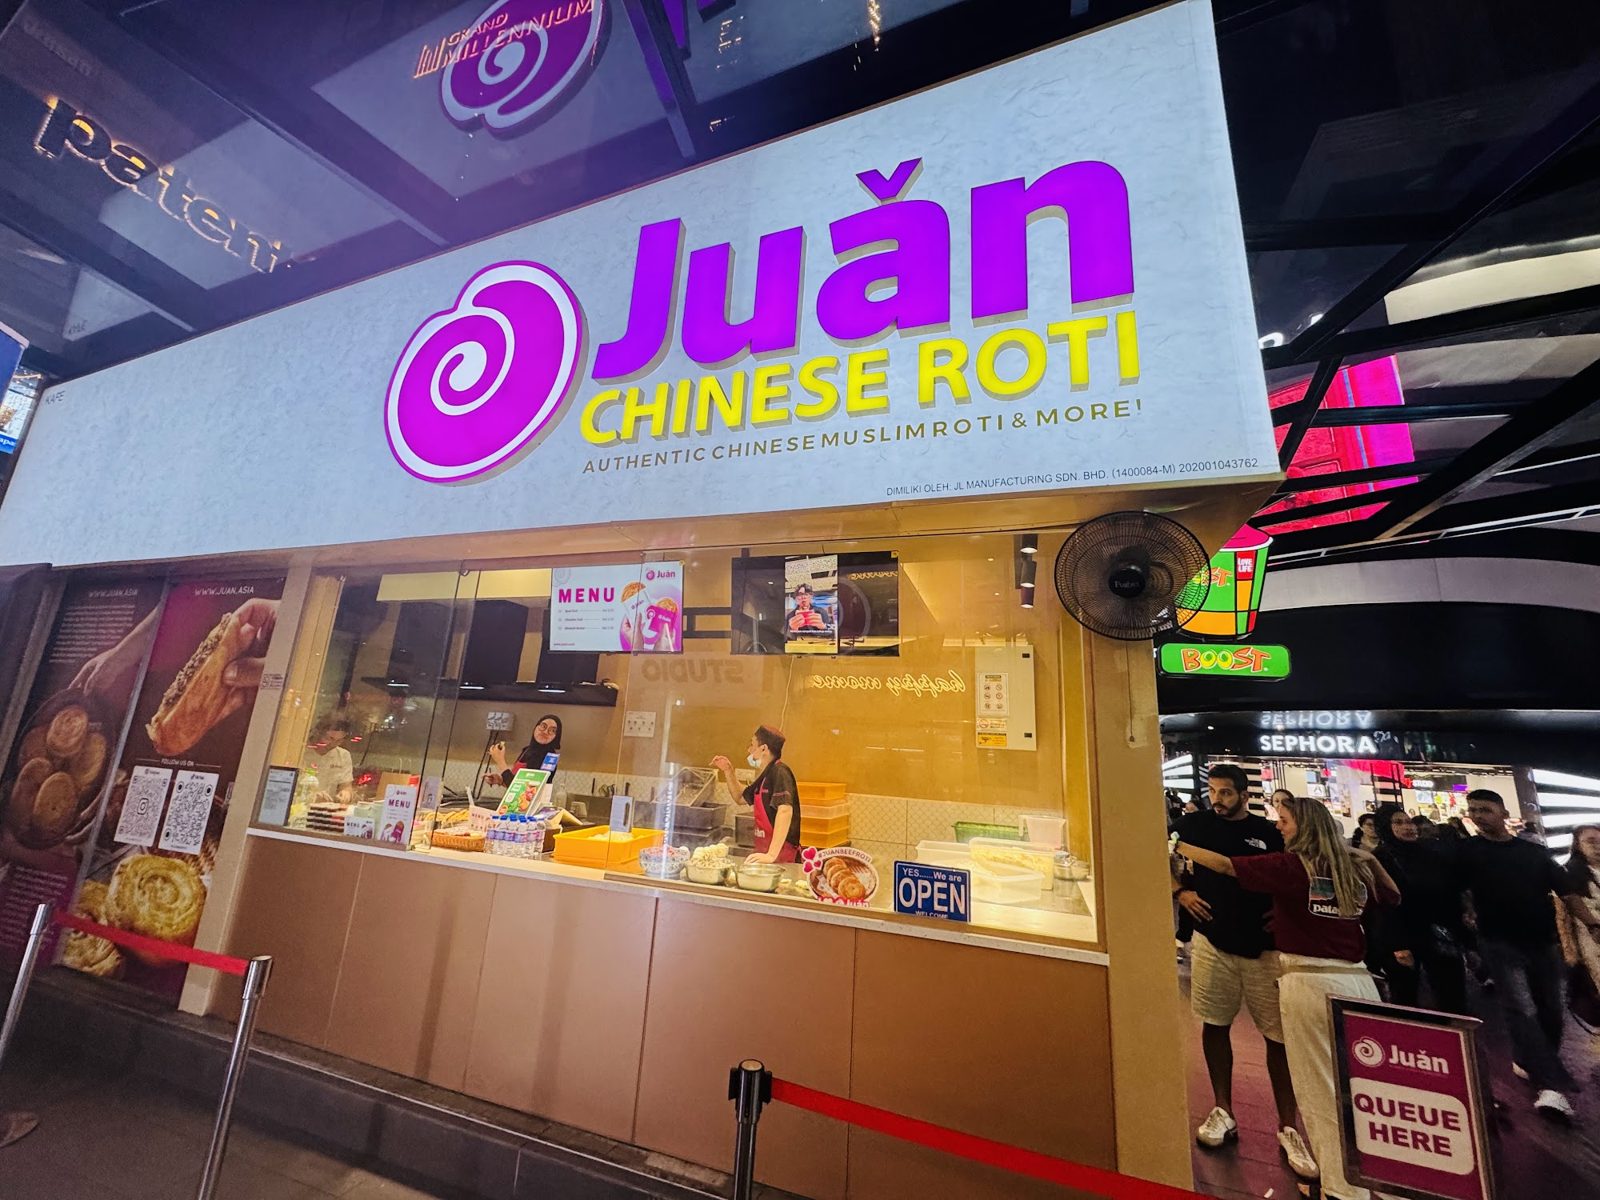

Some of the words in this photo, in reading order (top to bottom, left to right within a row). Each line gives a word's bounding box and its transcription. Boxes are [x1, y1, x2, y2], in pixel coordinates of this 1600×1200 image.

[447, 13, 508, 46] GRAND
[579, 348, 891, 446] CHINESE
[918, 310, 1140, 408] ROTI
[582, 447, 706, 474] AUTHENTIC
[712, 434, 816, 460] CHINESE
[821, 422, 925, 448] MUSLIM
[933, 414, 1003, 438] ROTI
[1011, 412, 1027, 428] &
[1036, 399, 1142, 426] MORE!
[886, 484, 922, 496] DIMILIKI
[924, 482, 951, 493] OLEH:
[954, 481, 964, 491] JL
[966, 473, 1053, 490] MANUFACTURING
[1055, 471, 1081, 483] SDN.
[1083, 468, 1109, 480] BHD.
[1112, 464, 1176, 479] (1400084-M)
[1179, 458, 1259, 473] 202001043762
[1237, 557, 1253, 566] LOVE
[1238, 565, 1252, 573] LIFE
[195, 586, 255, 596] WWW.JUAN.ASIA
[558, 587, 615, 603] MENU
[1181, 646, 1271, 673] BOOST
[1260, 734, 1377, 754] SEPHORA
[388, 799, 411, 809] MENU
[818, 848, 872, 862] #JUANBEEFROTI
[948, 874, 962, 882] are
[898, 877, 966, 915] OPEN
[1353, 1092, 1461, 1132] QUEUE
[1368, 1120, 1452, 1157] HERE
